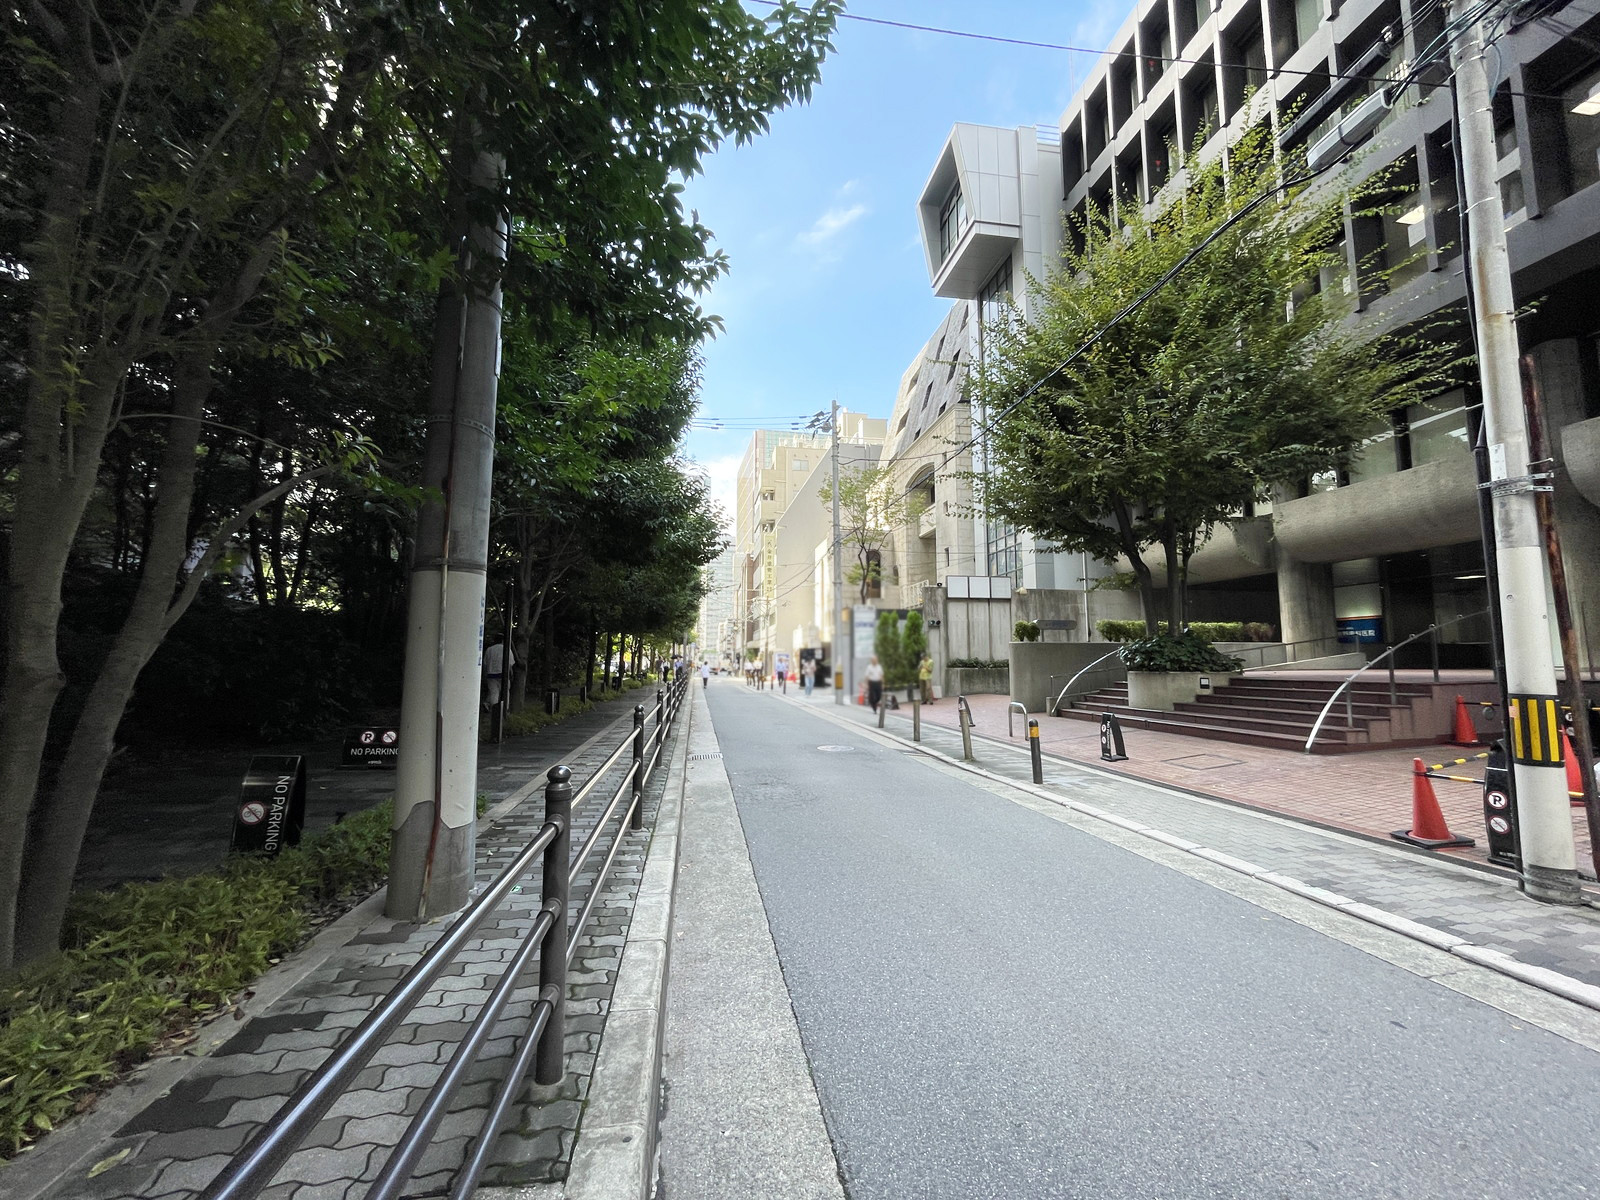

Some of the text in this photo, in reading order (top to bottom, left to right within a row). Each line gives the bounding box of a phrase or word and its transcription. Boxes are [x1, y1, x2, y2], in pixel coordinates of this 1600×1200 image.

[350, 747, 364, 756] NO
[264, 775, 291, 851] NO PARKING
